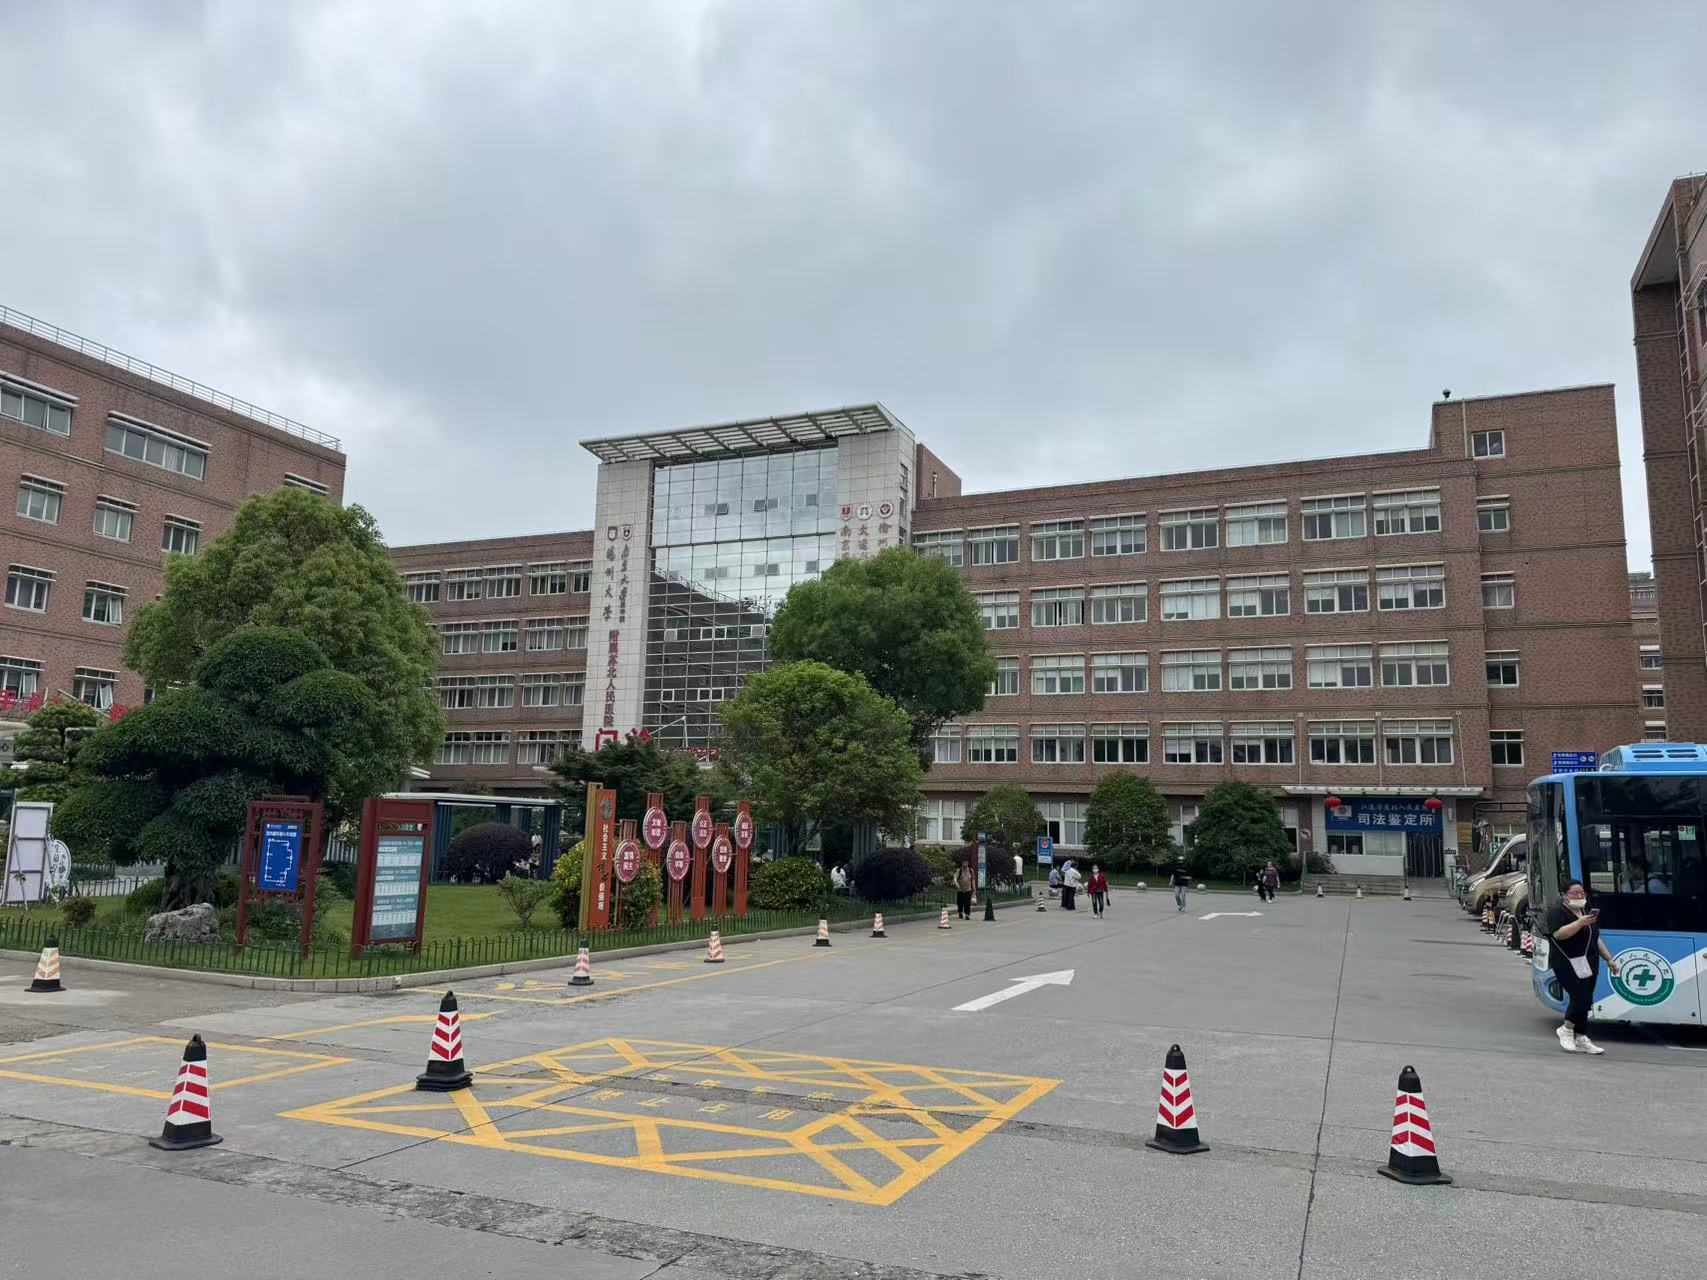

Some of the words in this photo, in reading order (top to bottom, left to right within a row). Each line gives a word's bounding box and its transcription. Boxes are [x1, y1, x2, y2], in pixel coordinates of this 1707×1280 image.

[1357, 813, 1433, 826] 司法鉴定所
